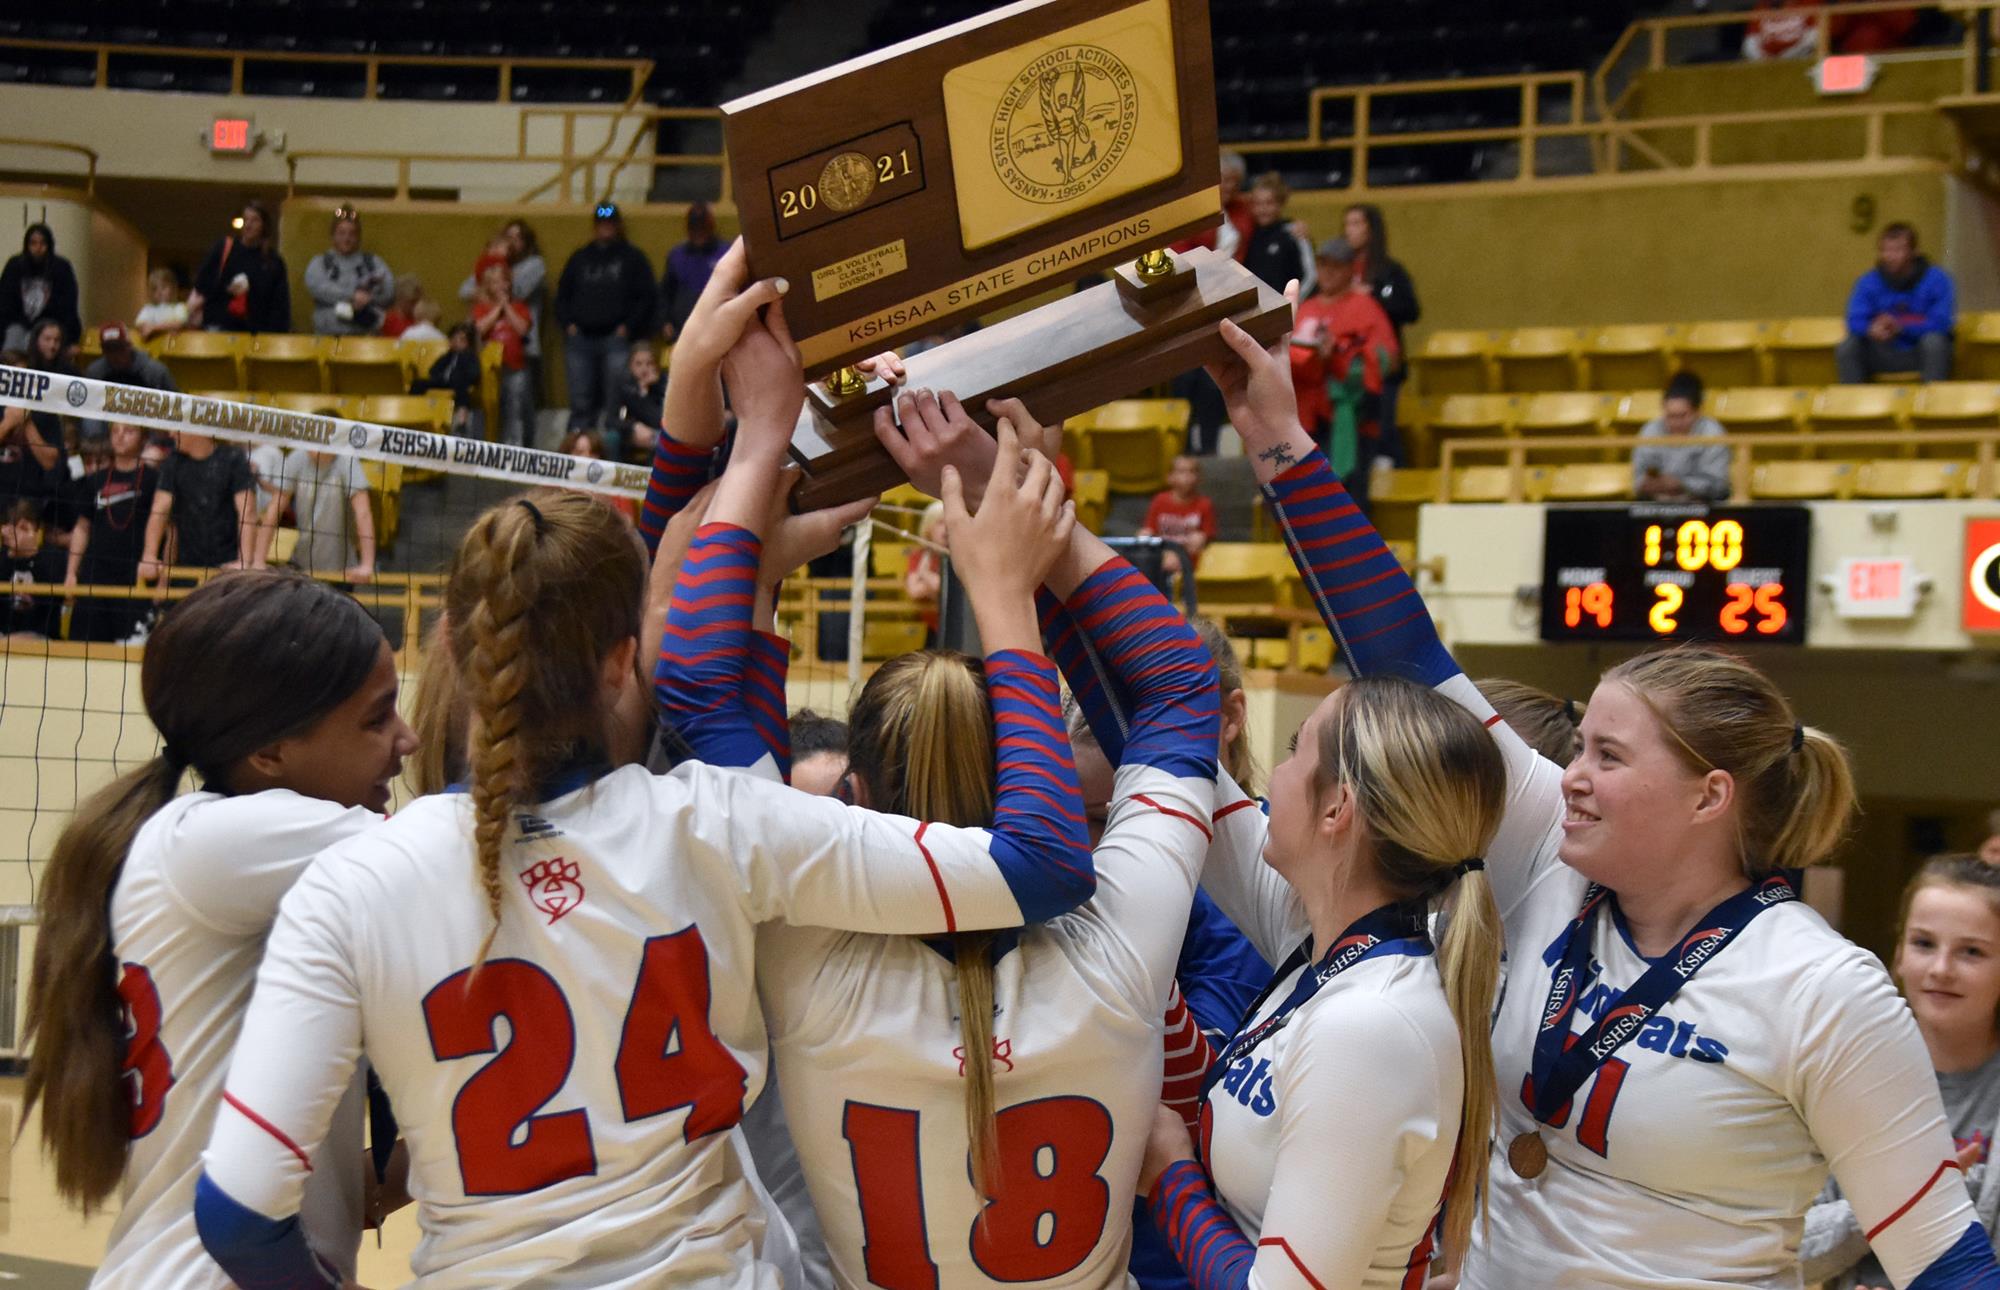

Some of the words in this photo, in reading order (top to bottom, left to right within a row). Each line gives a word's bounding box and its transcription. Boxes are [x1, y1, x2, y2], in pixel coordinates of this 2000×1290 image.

[1019, 48, 1072, 85] SCHOOL
[1076, 48, 1131, 90] ACTIVITIES
[997, 86, 1021, 122] HIGH
[993, 126, 1008, 167] STATE
[1091, 92, 1135, 183] ASSOCIATION
[780, 184, 817, 219] 20
[877, 149, 913, 183] 21
[1004, 167, 1048, 199] KANSAS
[1056, 180, 1087, 200] 1956
[816, 265, 843, 281] GIRLS
[845, 245, 900, 269] VOLLEYBALL
[839, 265, 868, 281] CLASS
[871, 260, 881, 269] 1A
[839, 271, 875, 290] DIVISION
[849, 299, 937, 344] KSHSAA
[947, 268, 1015, 306] STATE
[1026, 219, 1151, 276] CHAMPIONS
[102, 384, 183, 422] KSHSAA
[190, 398, 336, 445] CHAMPIONSHIP
[380, 429, 448, 461] KSHSAA
[453, 441, 577, 480] CHAMPIONSHIP
[1644, 520, 1744, 571] 1:00
[1850, 562, 1903, 601] EXIT
[1564, 582, 1614, 628] 19
[1649, 583, 1684, 633] 2
[1719, 582, 1788, 634] 25
[1315, 933, 1381, 987] KSHSAA
[1672, 925, 1733, 979] KSHSAA
[1541, 967, 1574, 1033] KSHSAA
[1589, 1003, 1652, 1061] KSHSAA
[421, 922, 749, 1197] 24
[842, 1095, 1114, 1290] 18
